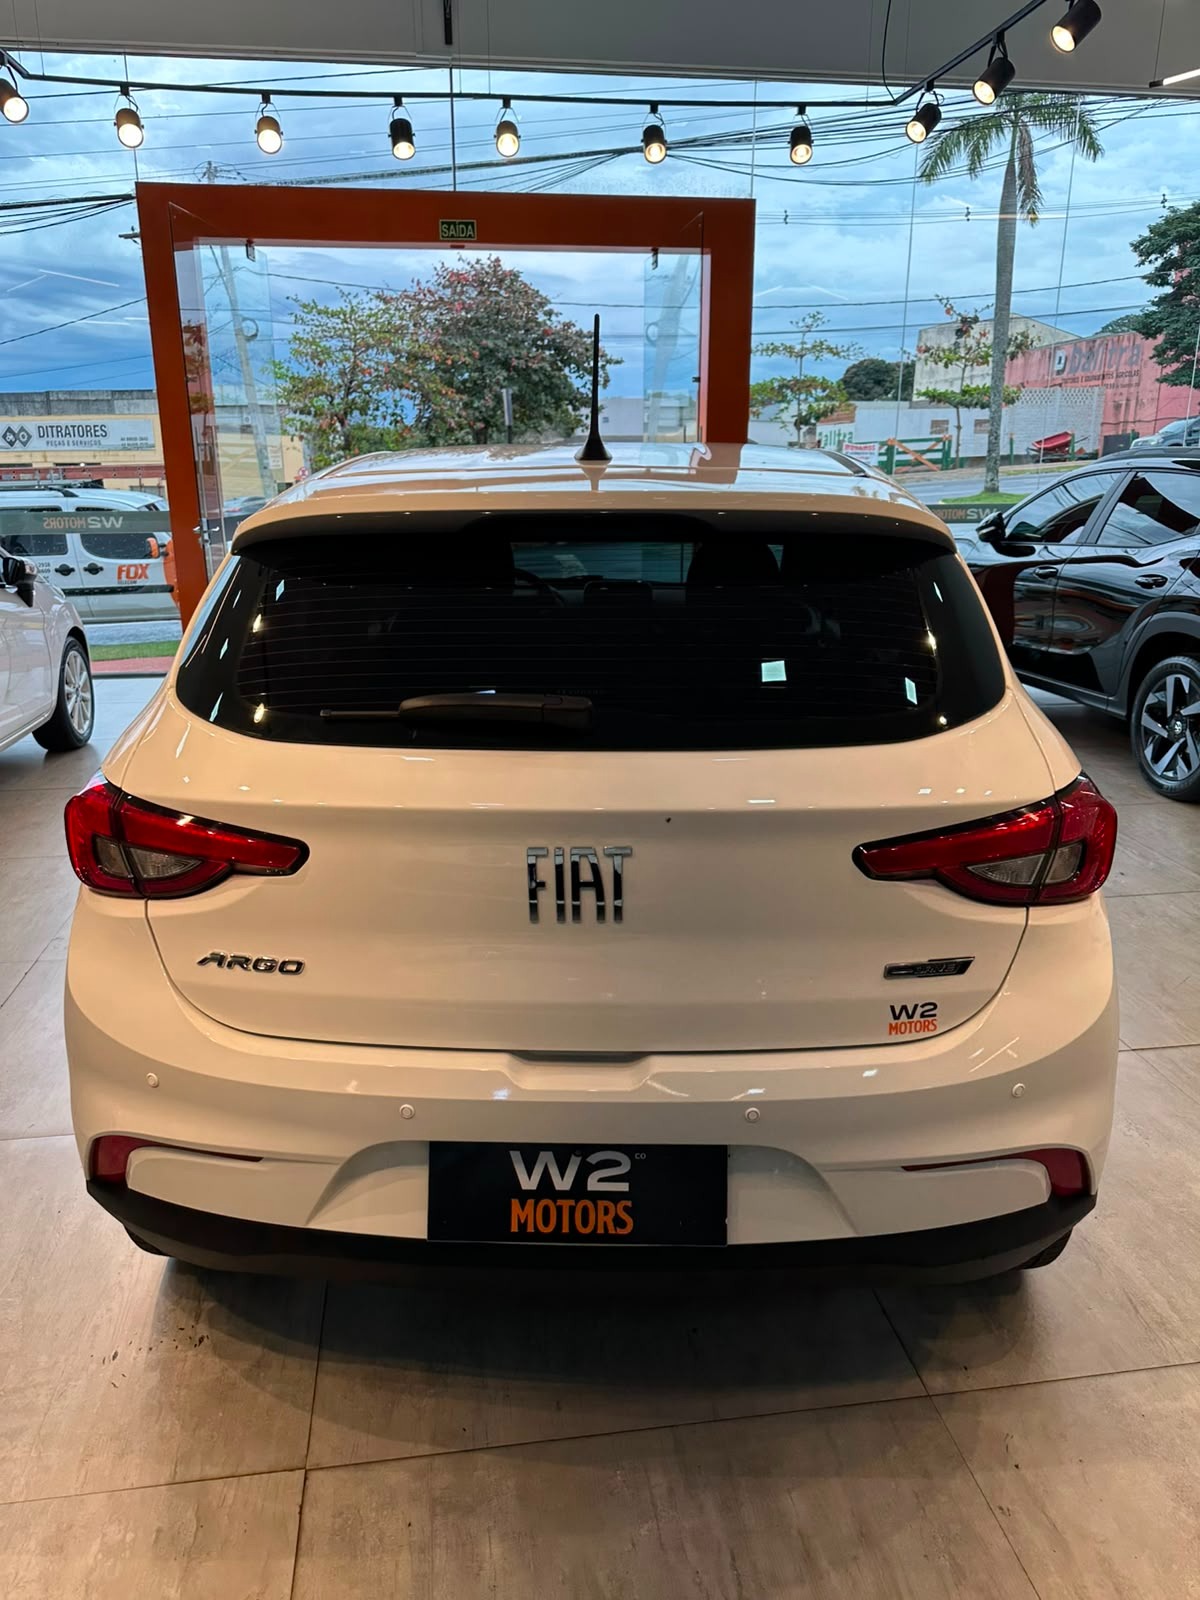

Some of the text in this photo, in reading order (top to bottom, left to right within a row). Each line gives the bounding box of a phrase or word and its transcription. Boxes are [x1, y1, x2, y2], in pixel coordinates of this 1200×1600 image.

[38, 424, 108, 438] DITRATORES
[46, 440, 65, 448] PEÇAS
[117, 564, 150, 580] FOX
[527, 846, 633, 924] FIAT
[197, 952, 305, 975] ARGO
[889, 1002, 938, 1021] W2
[888, 1019, 938, 1036] MOTORS
[509, 1150, 632, 1192] W2
[510, 1198, 634, 1235] MOTORS
